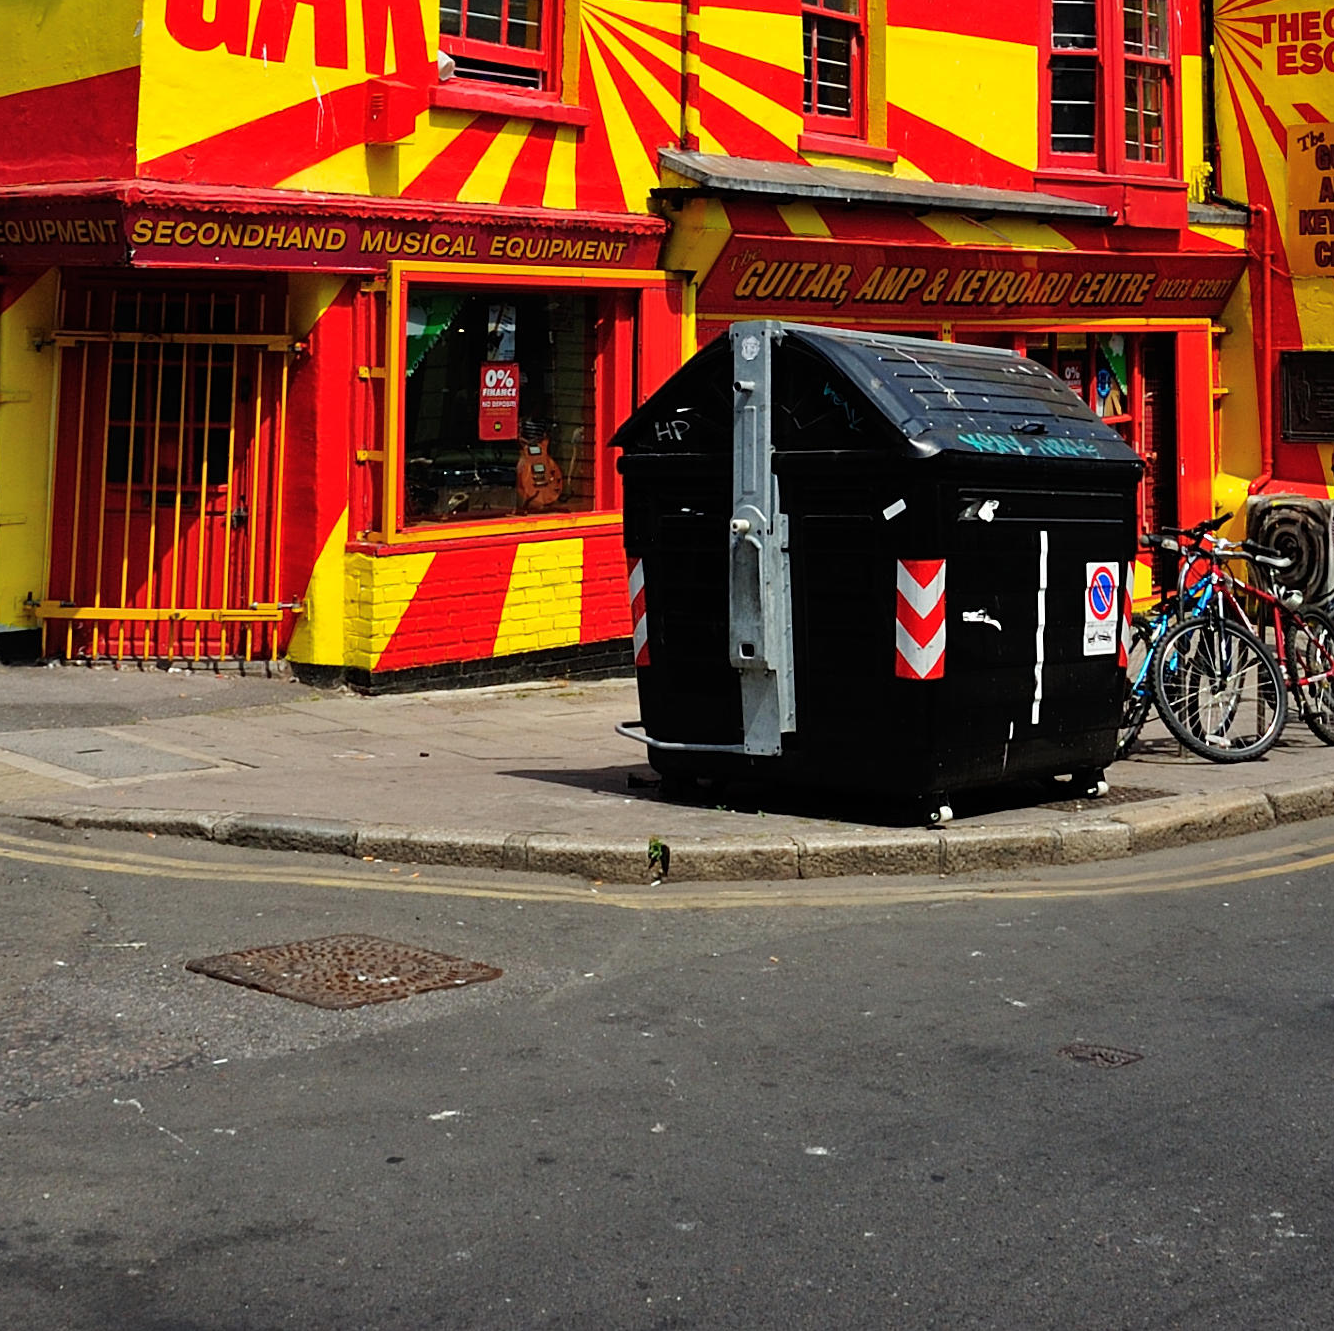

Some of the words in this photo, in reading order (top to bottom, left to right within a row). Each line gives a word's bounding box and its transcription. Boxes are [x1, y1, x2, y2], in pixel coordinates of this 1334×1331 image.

[1261, 11, 1322, 44] THE
[1297, 130, 1325, 152] The
[131, 219, 346, 252] SECONDHAND
[360, 230, 477, 257] MUSICAL
[489, 236, 628, 262] EQUIPMENT
[734, 261, 851, 305] GUITAR,
[854, 266, 926, 301] AMP
[922, 268, 949, 302] &
[945, 270, 1073, 304] KEYBOARD
[1069, 272, 1157, 304] CENTRE
[485, 369, 515, 388] 0%
[1065, 366, 1081, 379] 0%
[483, 388, 517, 397] FINANCE
[655, 420, 690, 441] HP
